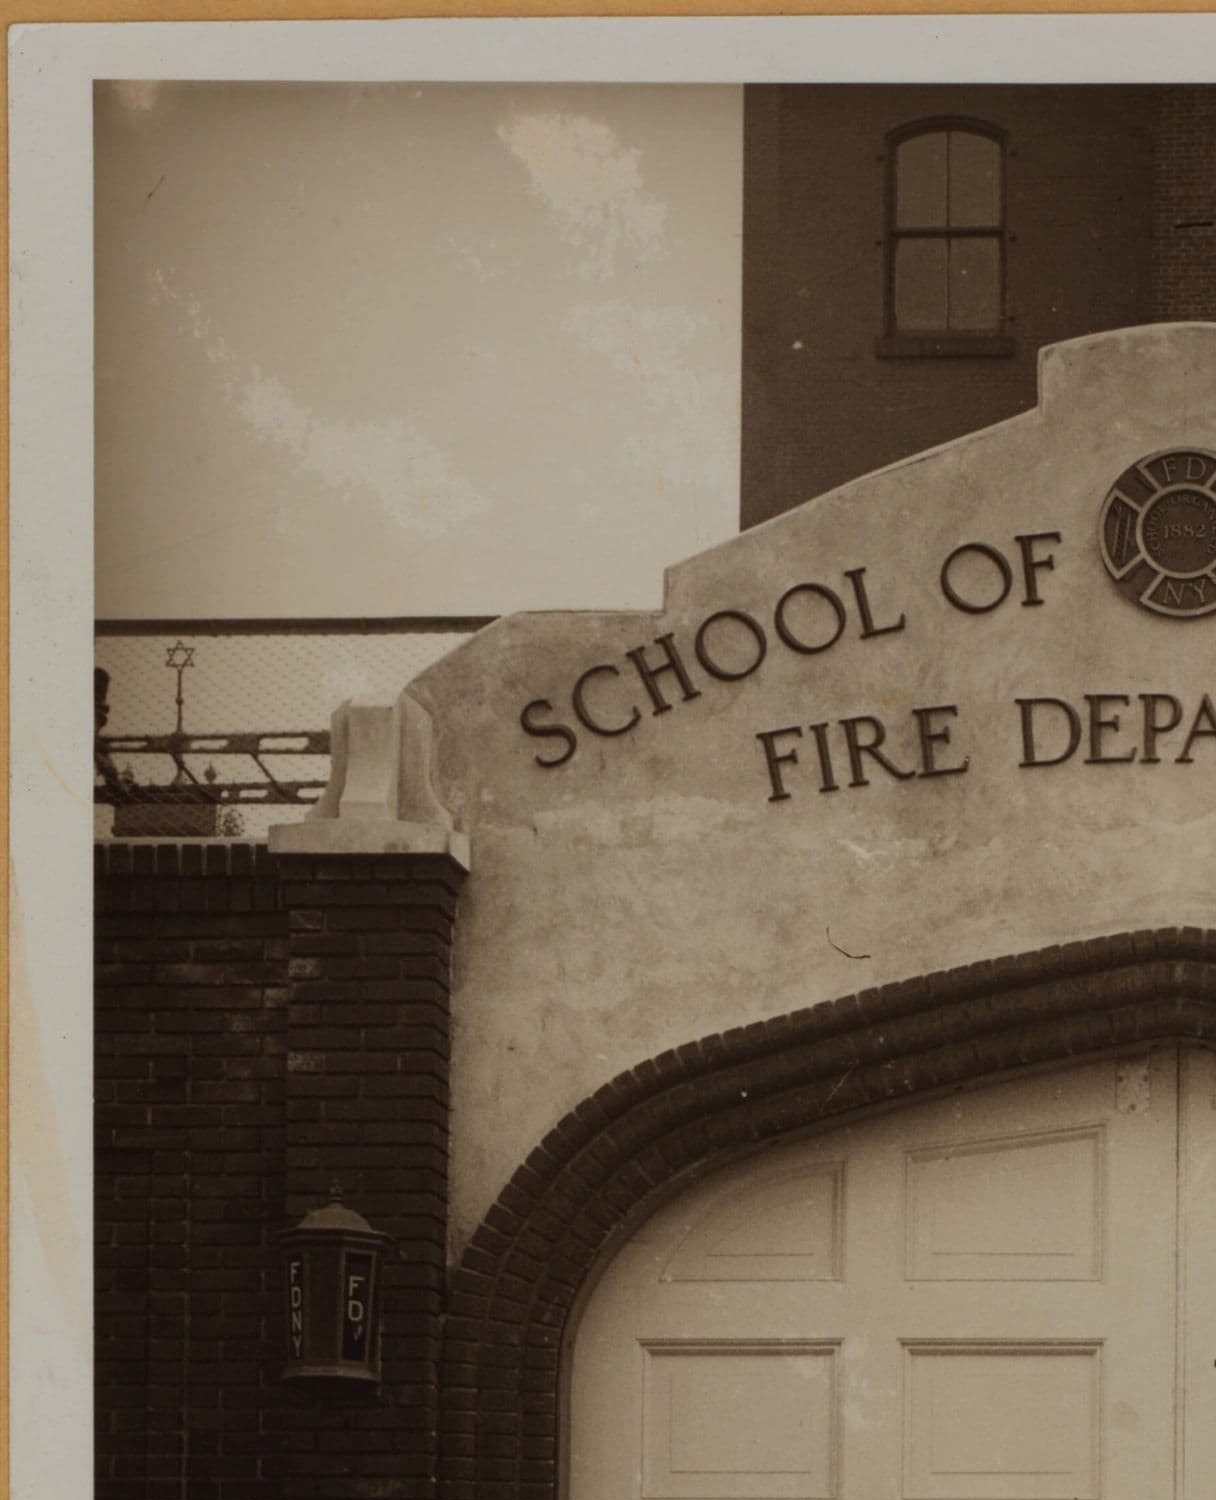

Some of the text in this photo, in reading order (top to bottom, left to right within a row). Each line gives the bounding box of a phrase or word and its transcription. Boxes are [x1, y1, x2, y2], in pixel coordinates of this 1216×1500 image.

[1164, 523, 1206, 539] 1882
[1163, 580, 1208, 605] NY
[519, 567, 906, 768] SCHOOL
[940, 531, 1061, 614] OF
[756, 704, 968, 802] FIRE
[289, 1261, 303, 1358] FDNY
